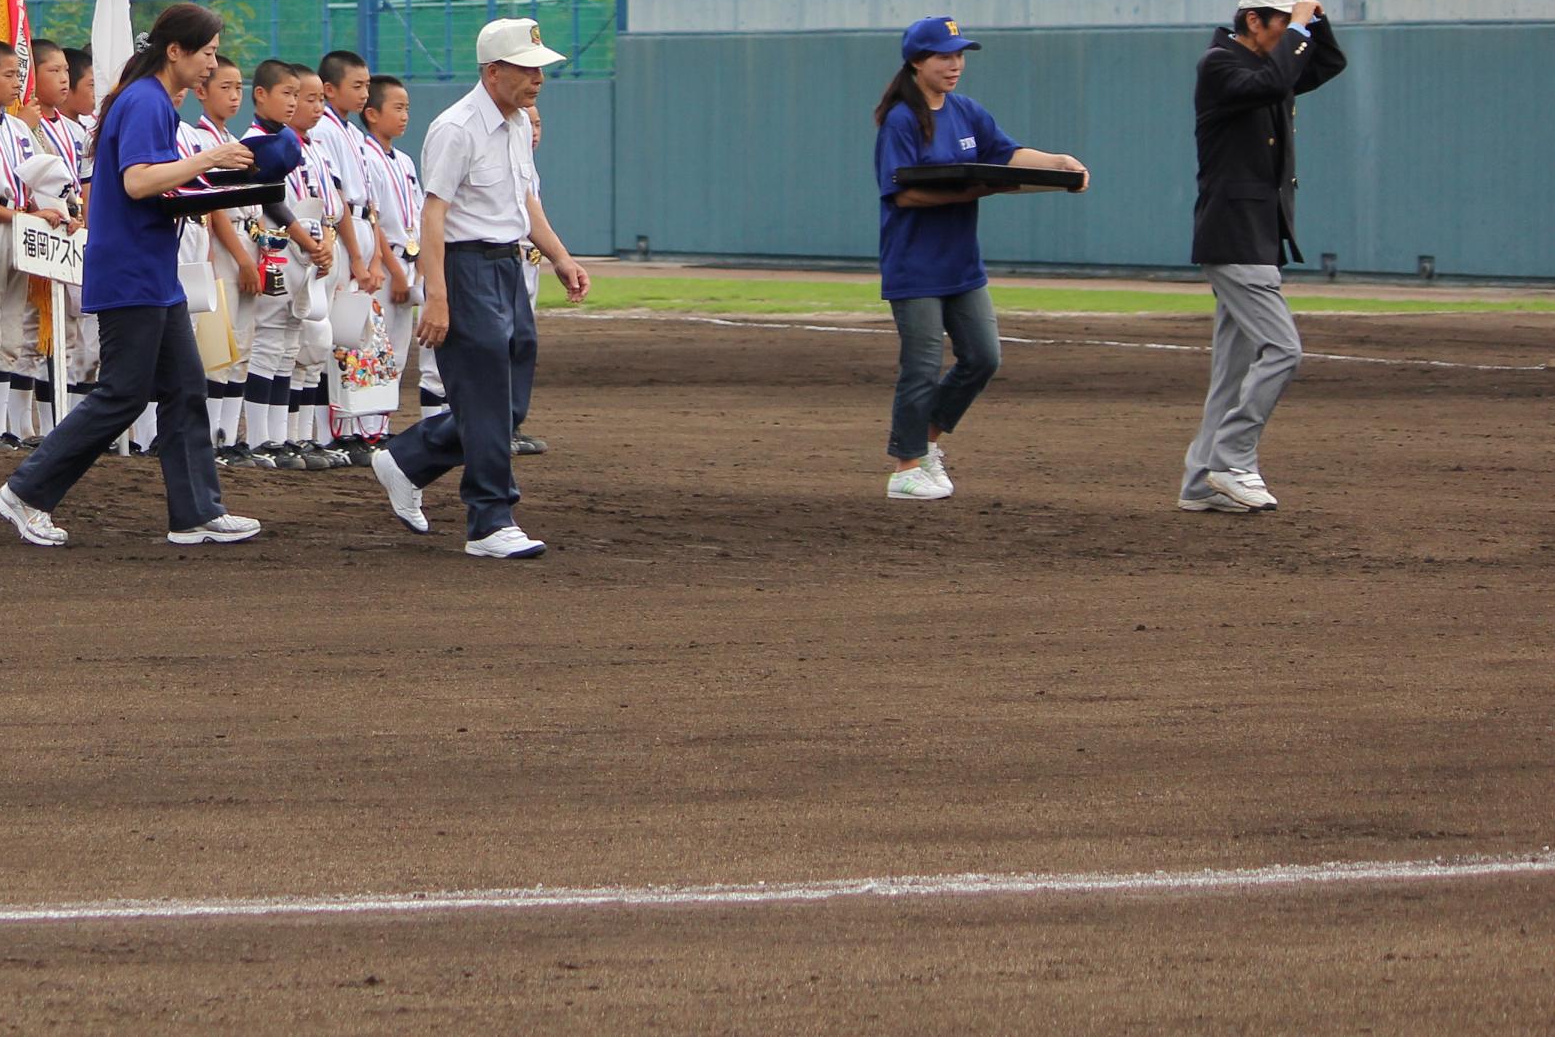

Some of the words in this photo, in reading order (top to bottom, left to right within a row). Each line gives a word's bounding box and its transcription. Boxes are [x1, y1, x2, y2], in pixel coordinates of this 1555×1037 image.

[23, 227, 85, 267] 福岡アスト
